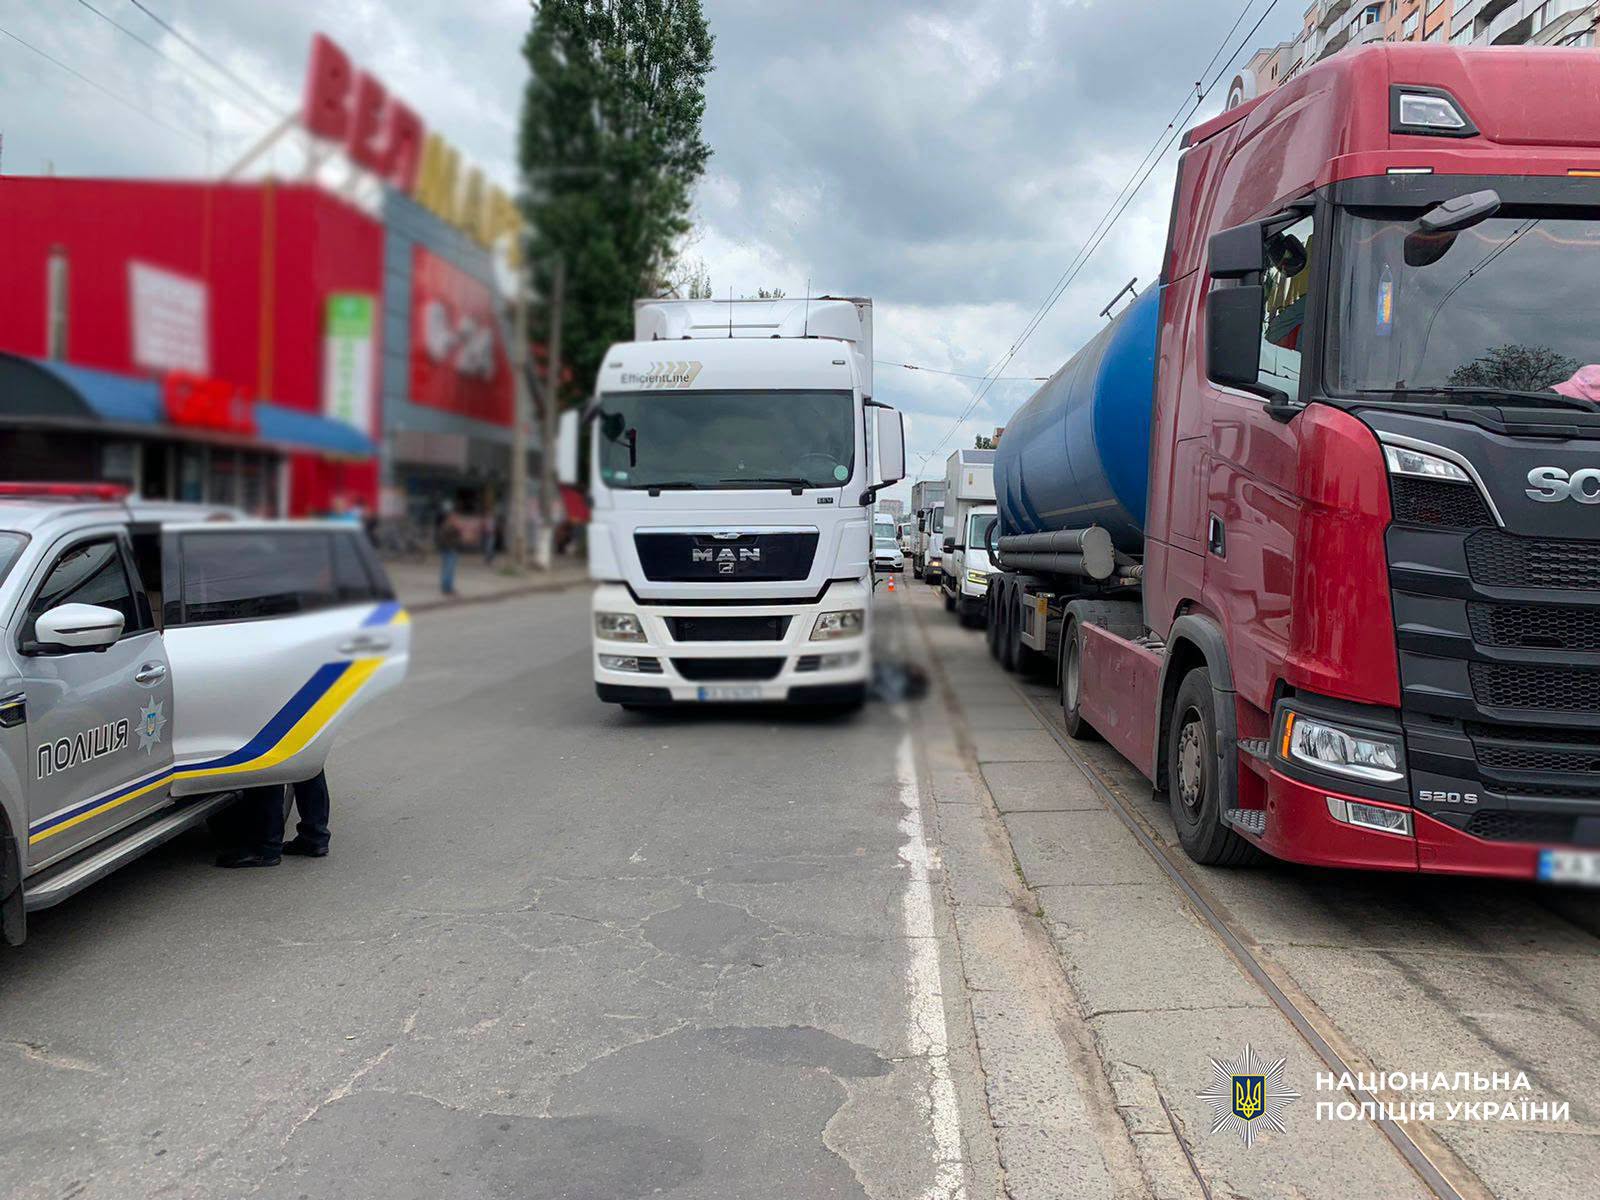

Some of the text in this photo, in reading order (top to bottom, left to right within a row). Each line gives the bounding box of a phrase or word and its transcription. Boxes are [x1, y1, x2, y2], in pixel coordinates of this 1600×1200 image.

[621, 372, 690, 385] EfficientLine
[692, 548, 760, 561] MAN
[36, 717, 130, 780] ПОЛІЦІЯ
[1419, 790, 1478, 804] 520 S
